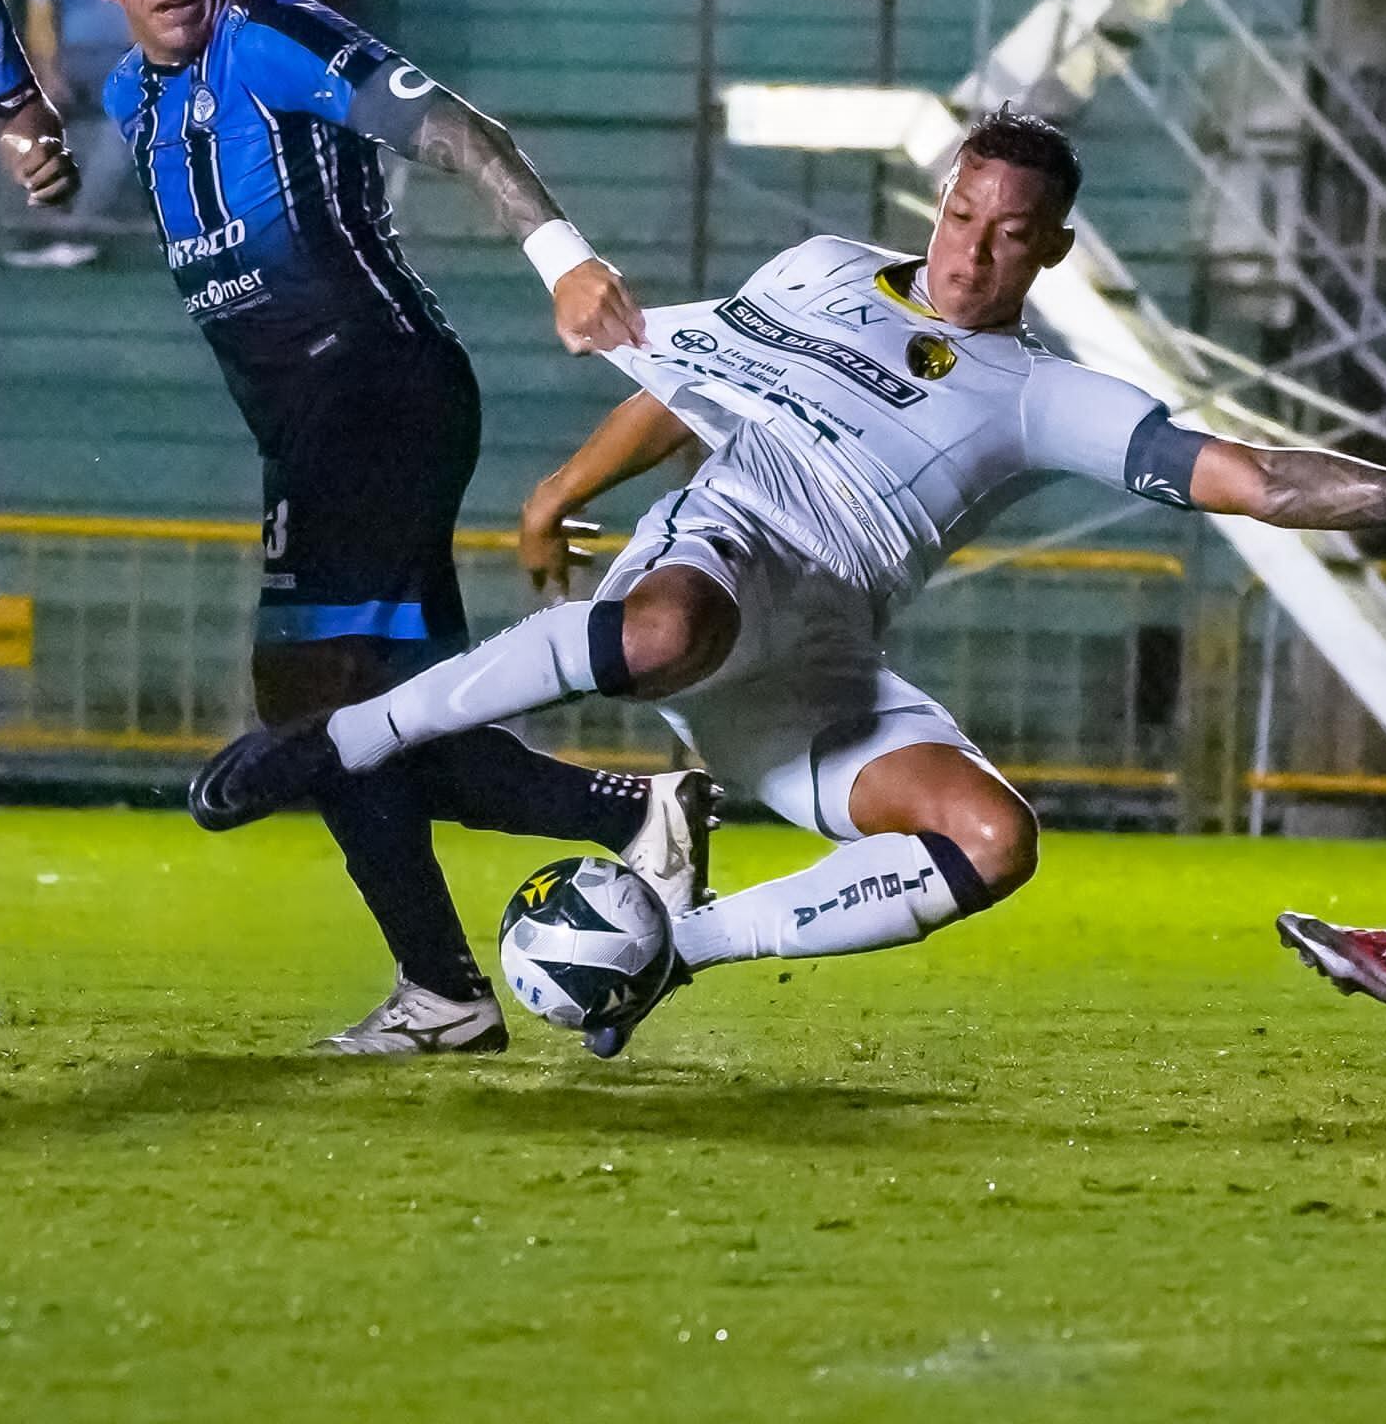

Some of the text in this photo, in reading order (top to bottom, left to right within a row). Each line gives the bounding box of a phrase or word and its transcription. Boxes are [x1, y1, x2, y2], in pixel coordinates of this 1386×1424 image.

[721, 347, 788, 377] Hospital
[732, 304, 783, 341] SUPER
[784, 333, 903, 394] BATERIAS
[793, 866, 935, 931] LIBERIA
